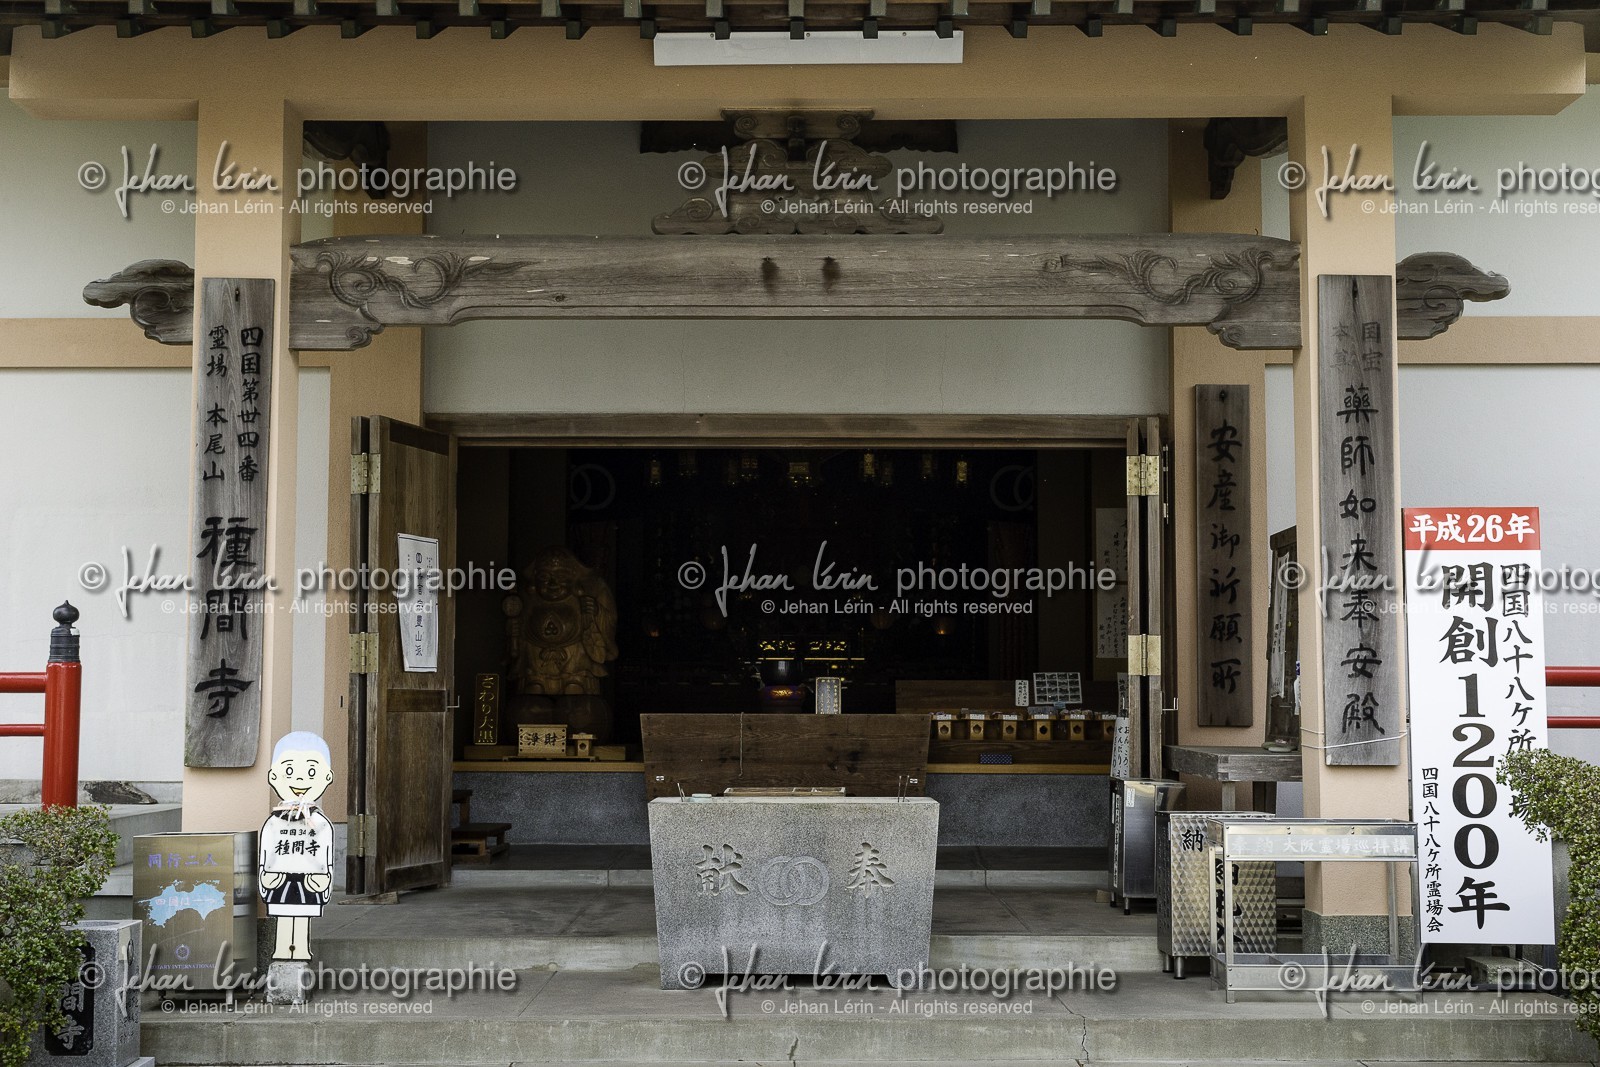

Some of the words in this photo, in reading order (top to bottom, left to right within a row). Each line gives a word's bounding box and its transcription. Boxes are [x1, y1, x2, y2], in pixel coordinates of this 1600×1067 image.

[1409, 513, 1535, 544] 平成26年
[195, 516, 258, 718] 種間寺
[1439, 562, 1510, 930] 開創1200年
[148, 853, 218, 868] 同行二人
[275, 840, 320, 856] 種間寺
